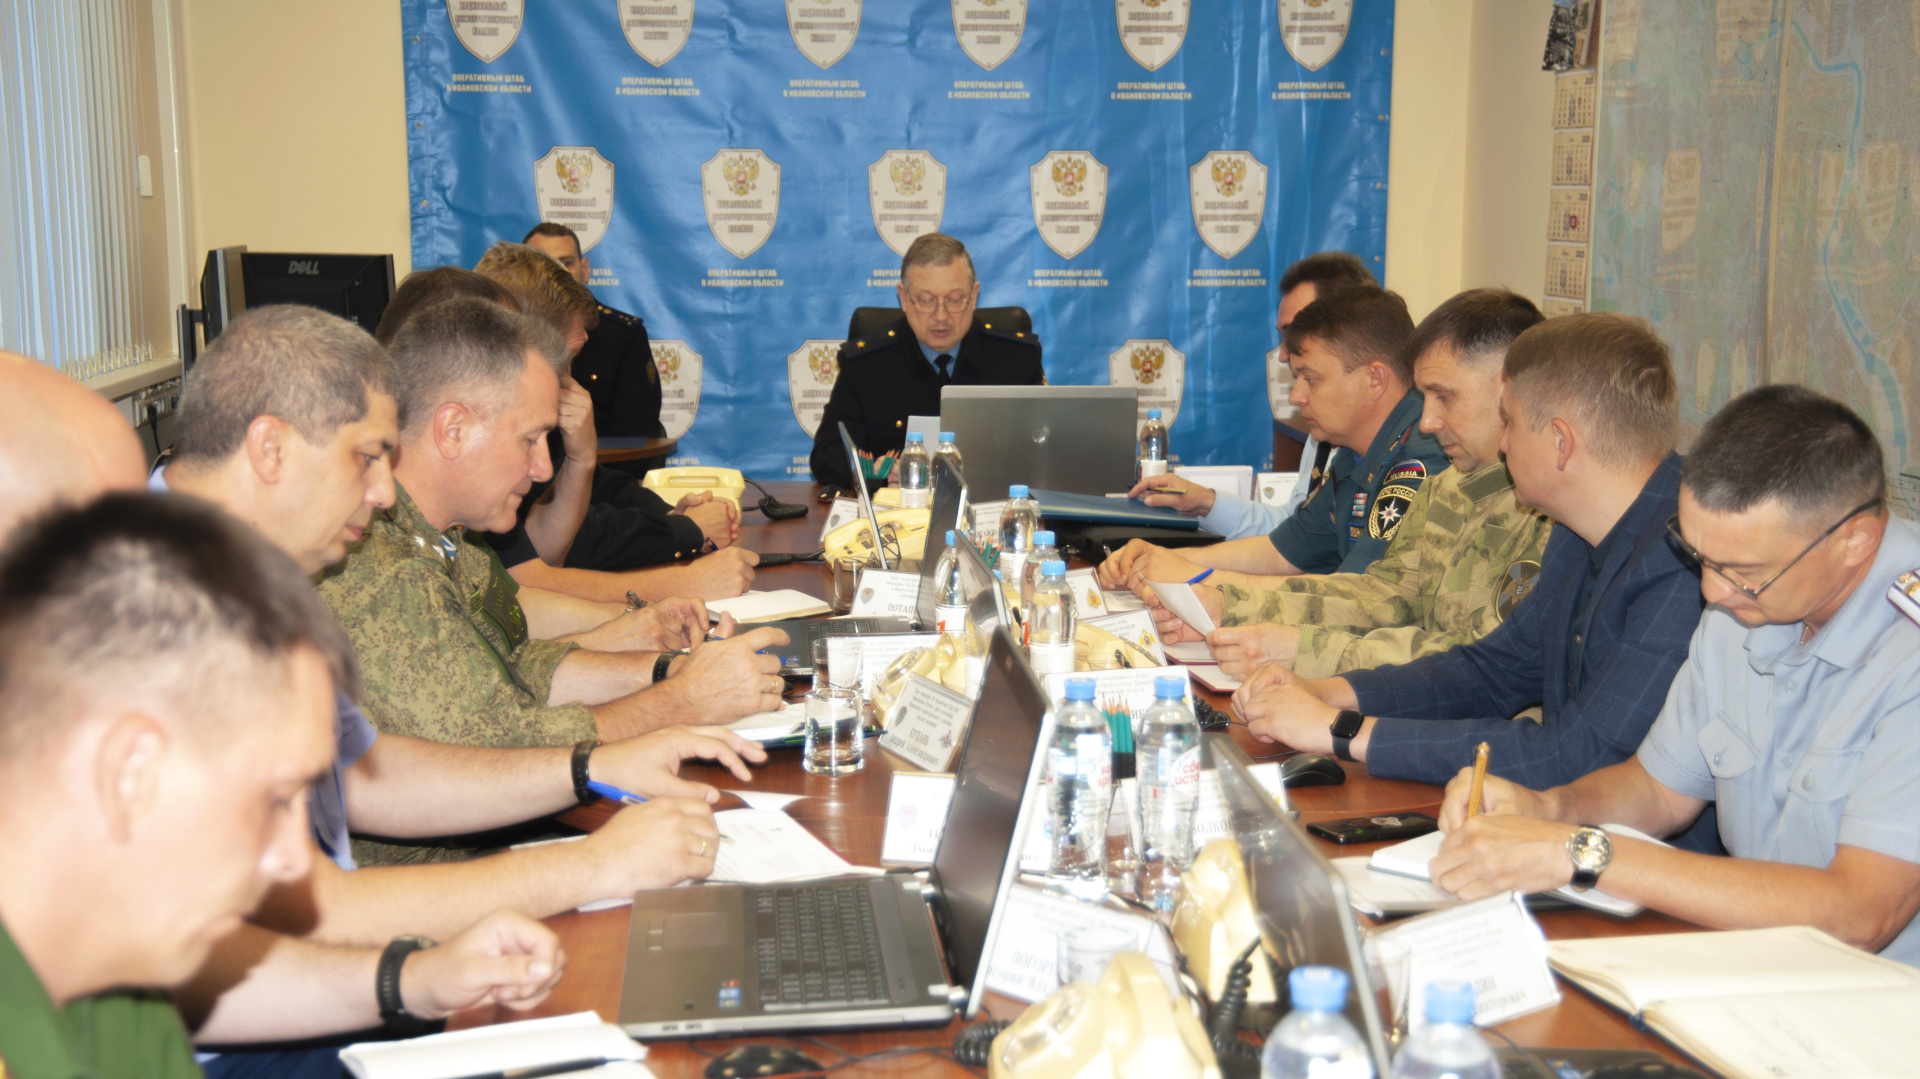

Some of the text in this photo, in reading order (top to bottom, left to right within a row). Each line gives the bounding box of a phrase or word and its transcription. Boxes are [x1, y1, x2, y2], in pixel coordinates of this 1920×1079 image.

[452, 73, 525, 83] ОПЕРАТИВНЫЙ ШТАБ
[622, 77, 694, 86] ОПЕРАТИВНЫЙ ШТАБ
[789, 79, 860, 88] ОПЕРАТИВНЫЙ ШТАБ
[954, 81, 1023, 89] ОПЕРАТИВНЫЙ ШТАБ
[1117, 82, 1186, 90] ОПЕРАТИВНЫЙ ШТАБ
[1327, 82, 1346, 90] ШТАБ
[453, 84, 498, 93] ИВАНОВСКОЙ
[499, 84, 532, 93] ОБЛАСТИ
[622, 87, 667, 96] ИВАНОВСКОЙ
[668, 87, 700, 96] ОБЛАСТИ
[835, 89, 867, 98] ОБЛАСТИ
[999, 90, 1030, 99] ОБЛАСТИ
[1161, 91, 1192, 100] ОБЛАСТИ
[287, 260, 319, 275] DELL
[592, 268, 613, 276] ШТАБ
[707, 269, 778, 277] ОПЕРАТИВНЫЙ ШТАБ
[872, 268, 901, 277] ОПЕРАТИ
[1083, 269, 1103, 277] ШТАБ
[753, 278, 784, 287] ОБЛАСТИ
[873, 278, 900, 287] ИВАНО
[1389, 471, 1418, 480] RUSSIA
[1393, 488, 1416, 499] РОССИ
